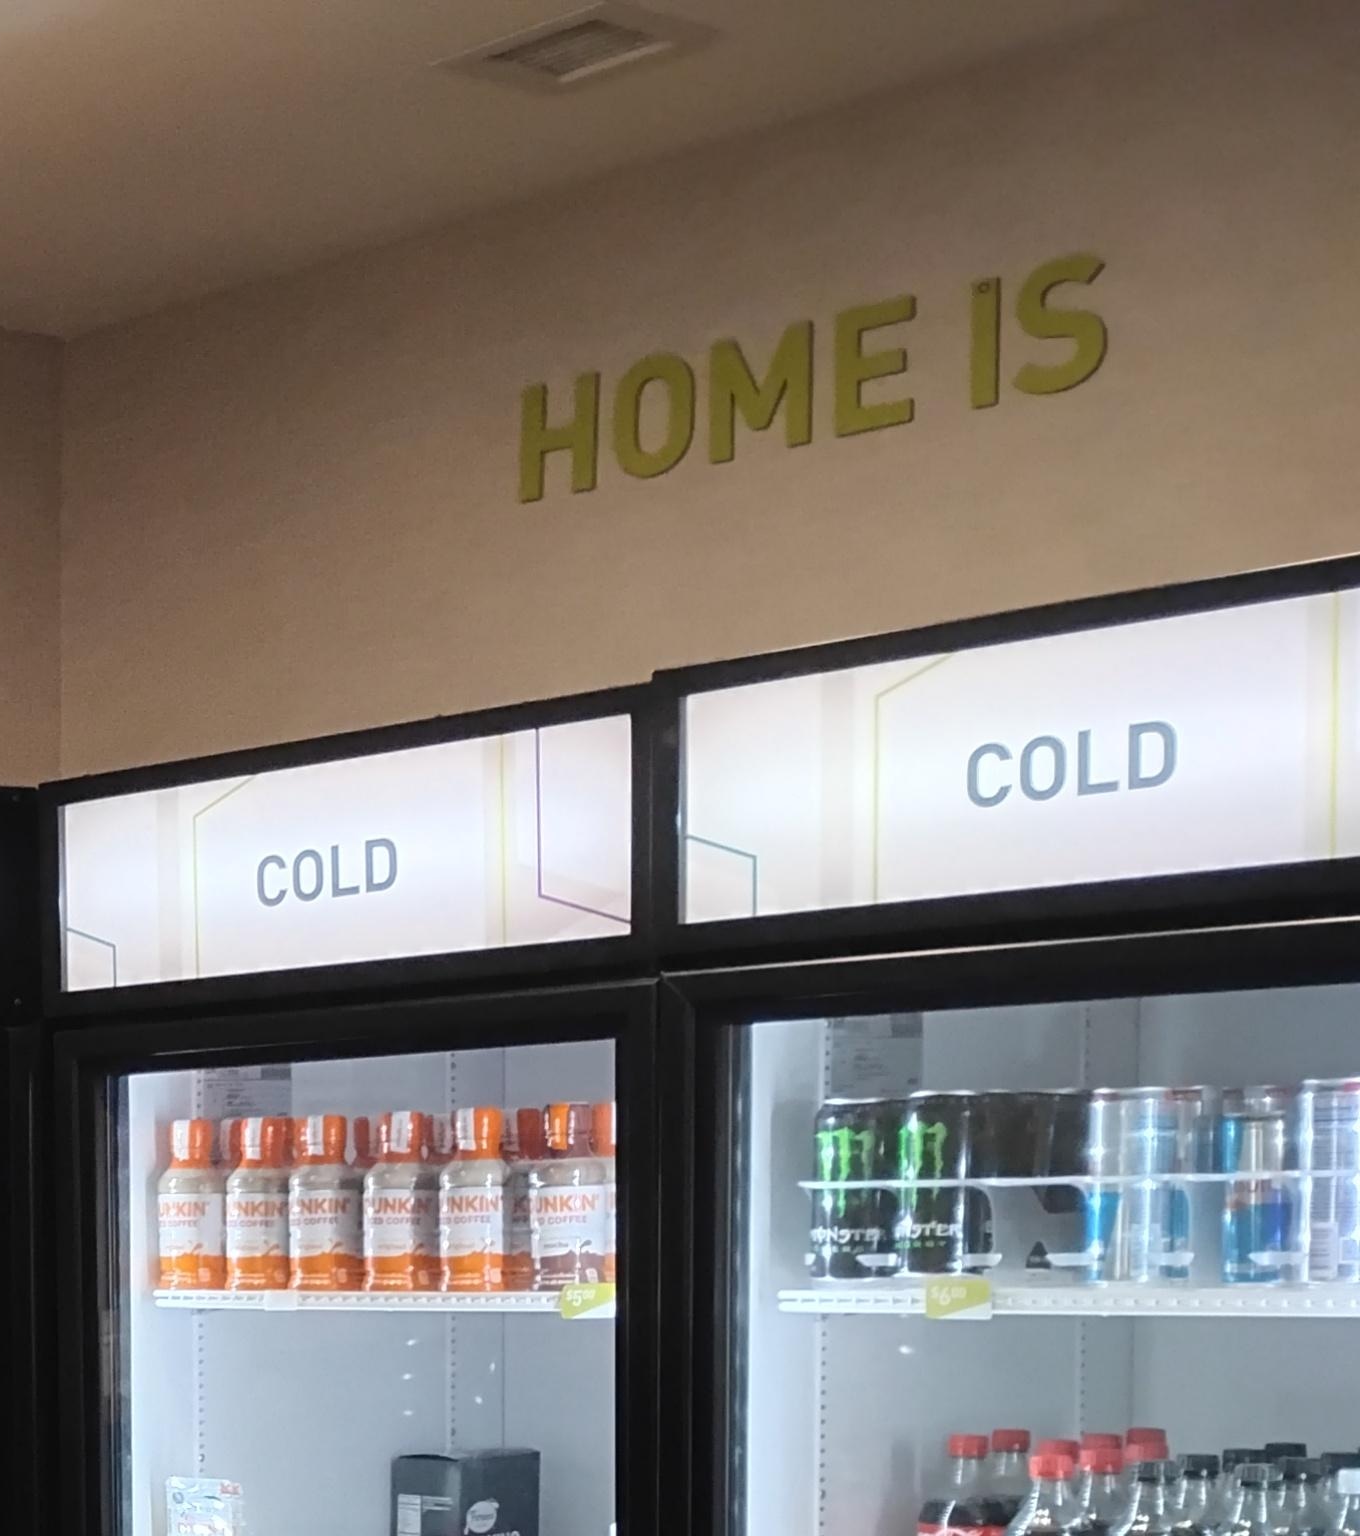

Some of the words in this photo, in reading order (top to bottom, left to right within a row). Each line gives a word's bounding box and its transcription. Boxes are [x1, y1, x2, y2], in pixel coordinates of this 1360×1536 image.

[518, 293, 917, 504] HOME
[970, 251, 1108, 408] IS
[967, 720, 1178, 808] COLD
[255, 836, 401, 909] COLD
